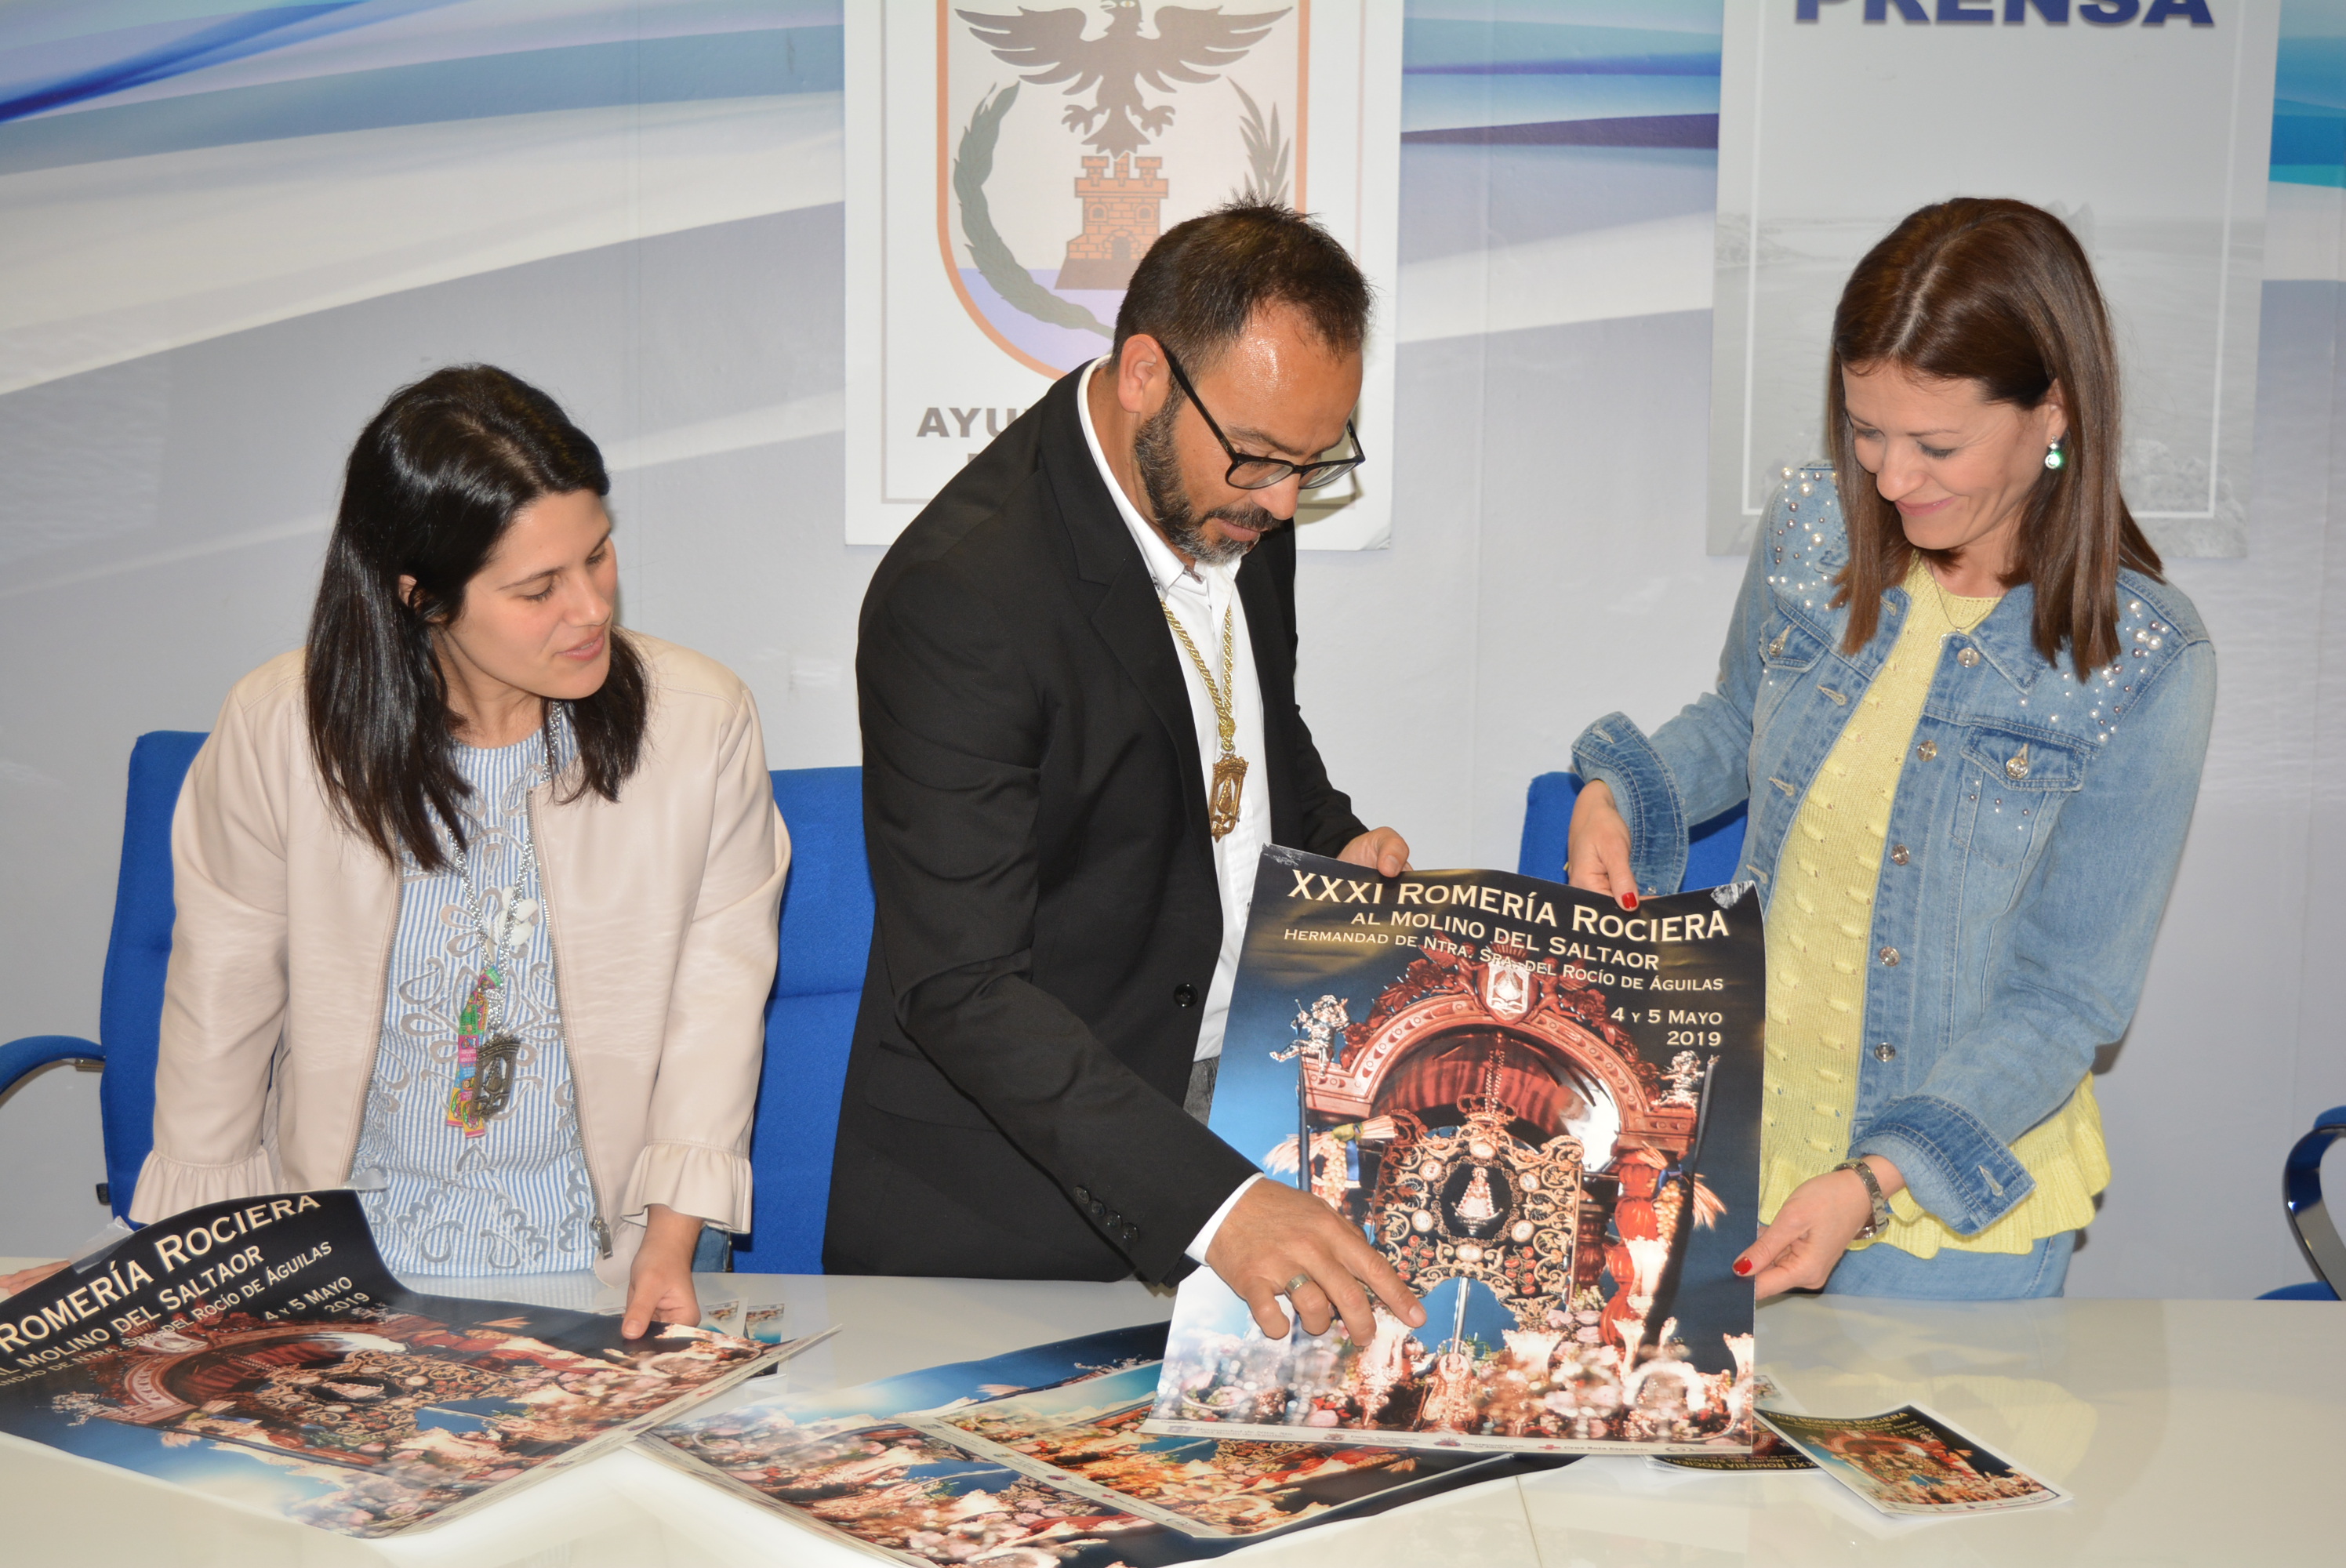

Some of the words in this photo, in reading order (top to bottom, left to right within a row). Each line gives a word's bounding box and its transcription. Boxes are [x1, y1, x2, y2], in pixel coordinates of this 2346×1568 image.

[916, 406, 1031, 437] AYU
[1287, 869, 1383, 904] XXXI
[1397, 882, 1557, 927] ROMERÍA
[1571, 904, 1729, 942] ROCIERA
[1284, 928, 1389, 944] HERMANDAD
[1395, 935, 1418, 947] DE
[1424, 938, 1473, 959] NTRA.
[1525, 960, 1557, 977] DEL
[1563, 964, 1615, 985] ROCÍO
[1621, 976, 1643, 990] DE
[1650, 975, 1723, 991] ÁGUILAS
[1351, 912, 1381, 926] AL
[1391, 910, 1485, 938] MOLINO
[1494, 927, 1540, 952] DEL
[1549, 937, 1660, 971] SALTAOR
[1611, 1007, 1625, 1022] 4
[1632, 1012, 1641, 1023] Y
[1647, 1009, 1661, 1024] 5
[1668, 1009, 1723, 1025] MAYO
[1666, 1030, 1722, 1047] 2019
[0, 1260, 154, 1353] ROMERÍA
[154, 1195, 321, 1272] ROCIERA
[264, 1311, 279, 1321] 4
[289, 1298, 307, 1311] 5
[303, 1276, 353, 1305] MAYO
[16, 1328, 111, 1367] MOLINO
[111, 1306, 161, 1334] DEL
[159, 1245, 264, 1310] SALTAOR
[48, 1362, 74, 1370] DE
[161, 1318, 194, 1333] DEL
[191, 1293, 241, 1321] ROCÍO
[241, 1279, 266, 1298] DE
[266, 1241, 332, 1287] ÁGUILAS
[325, 1292, 370, 1313] 2019
[1854, 1412, 1908, 1425] ROCIERA
